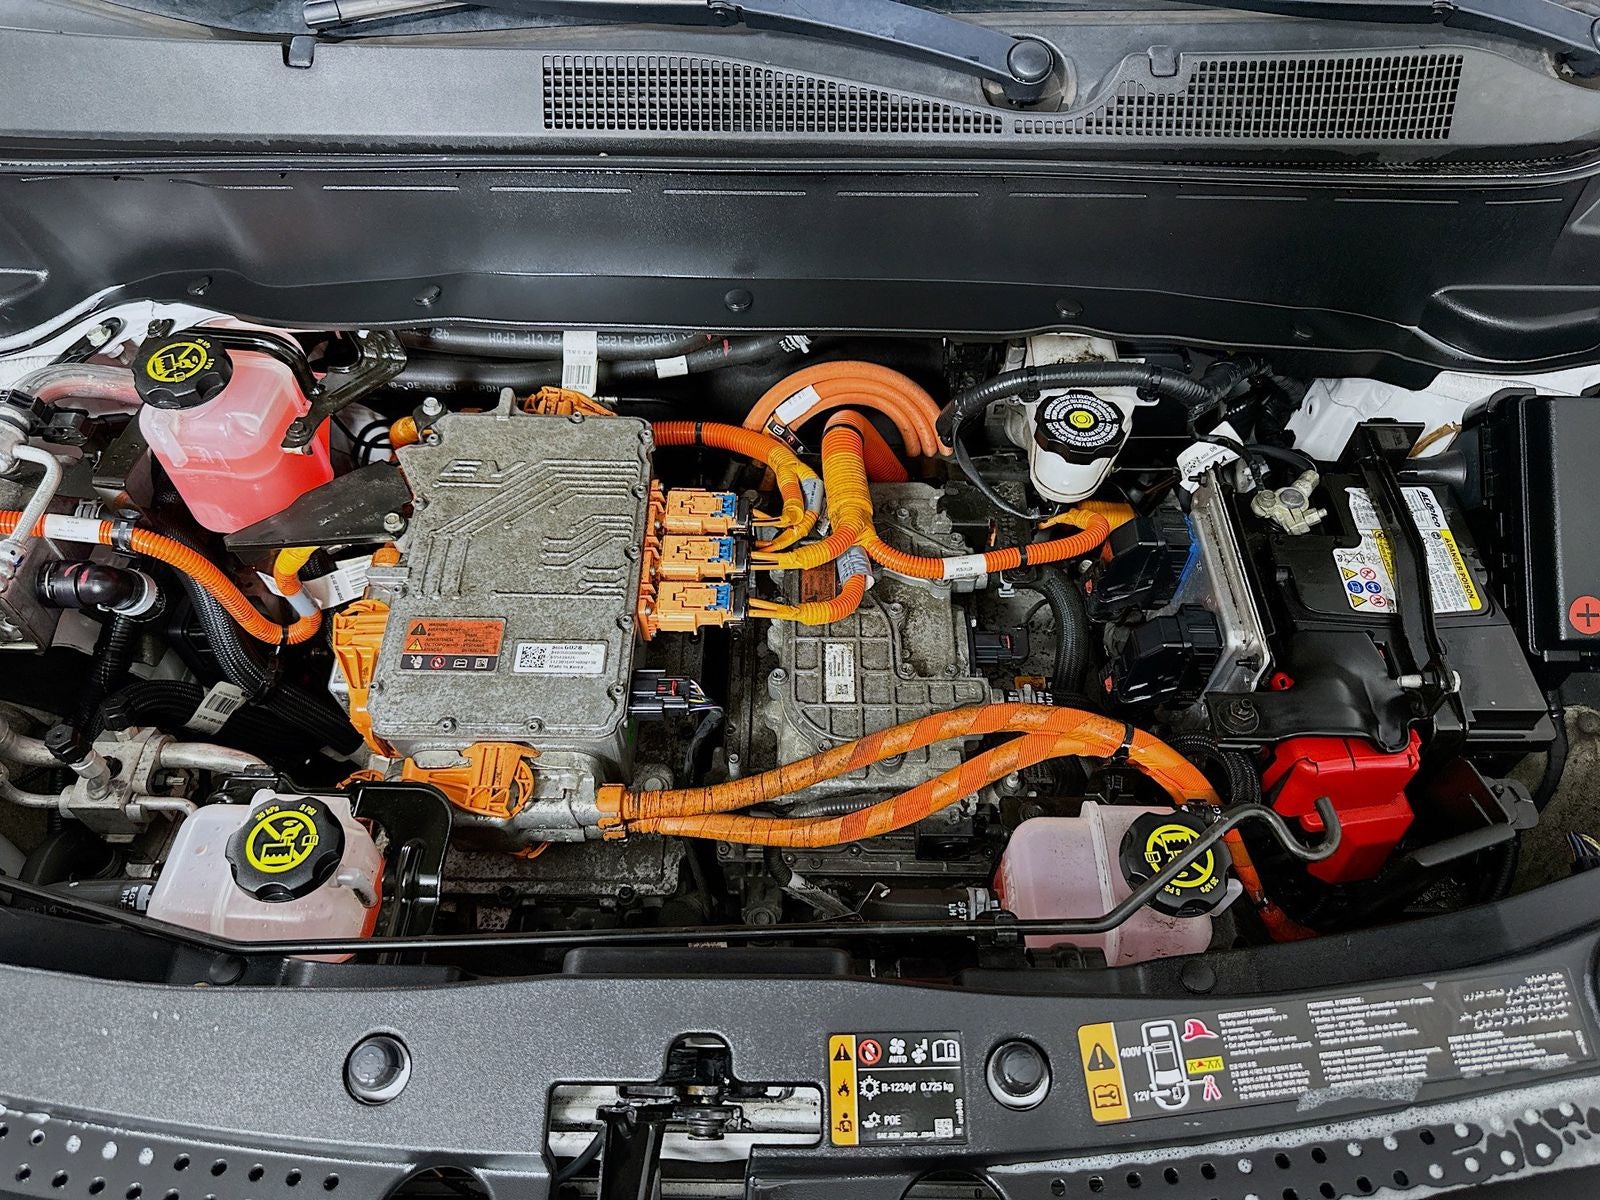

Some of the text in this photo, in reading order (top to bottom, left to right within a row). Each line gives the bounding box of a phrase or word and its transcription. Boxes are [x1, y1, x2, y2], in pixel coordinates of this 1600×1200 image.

[1416, 489, 1440, 528] ACDelco
[1121, 1046, 1142, 1058] 400V
[1133, 1090, 1150, 1102] 12V
